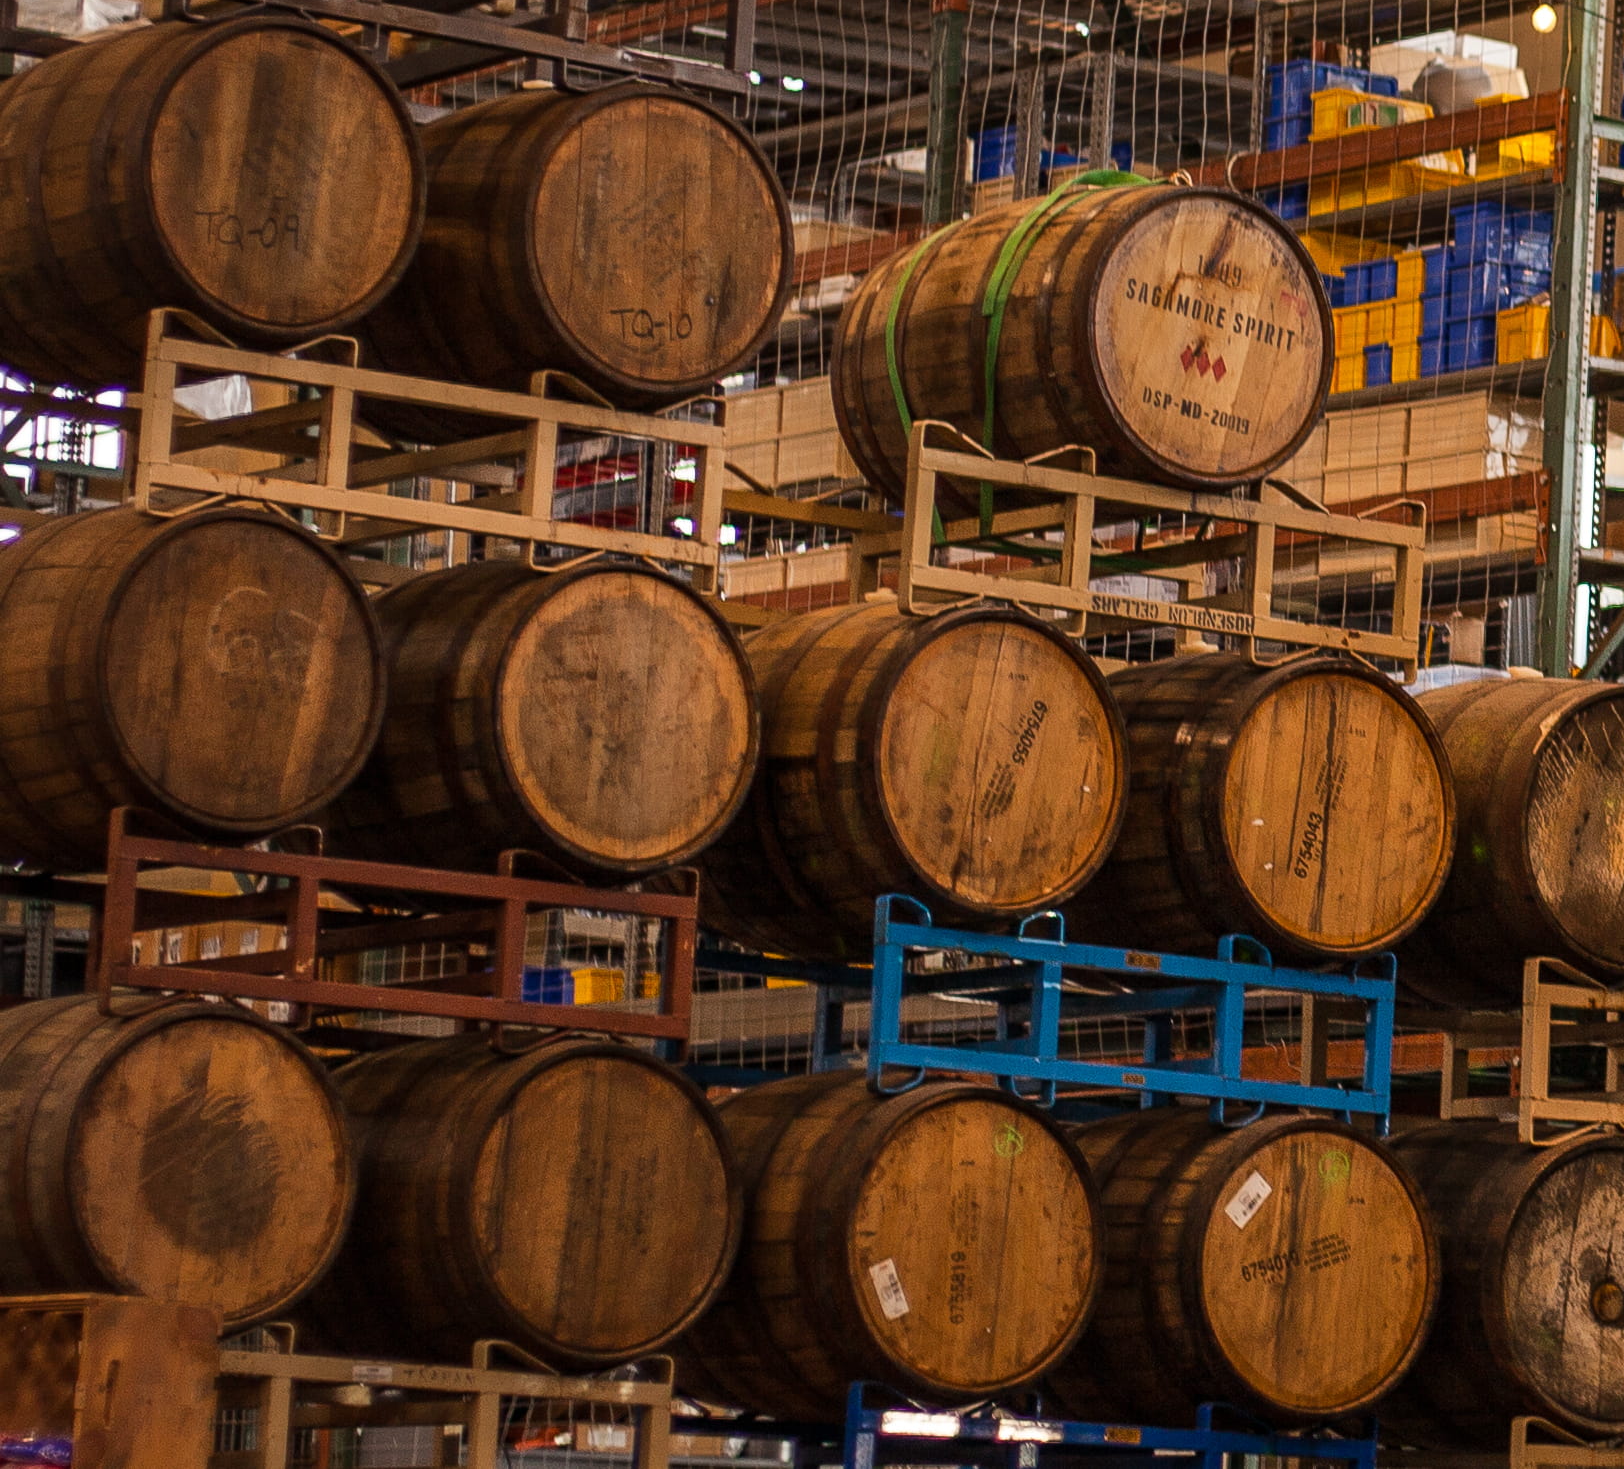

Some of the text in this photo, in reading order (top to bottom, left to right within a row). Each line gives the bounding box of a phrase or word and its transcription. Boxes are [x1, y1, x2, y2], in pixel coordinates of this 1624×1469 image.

[609, 308, 693, 341] TQ-10
[1126, 278, 1296, 352] SAGAMORE SPIRIT
